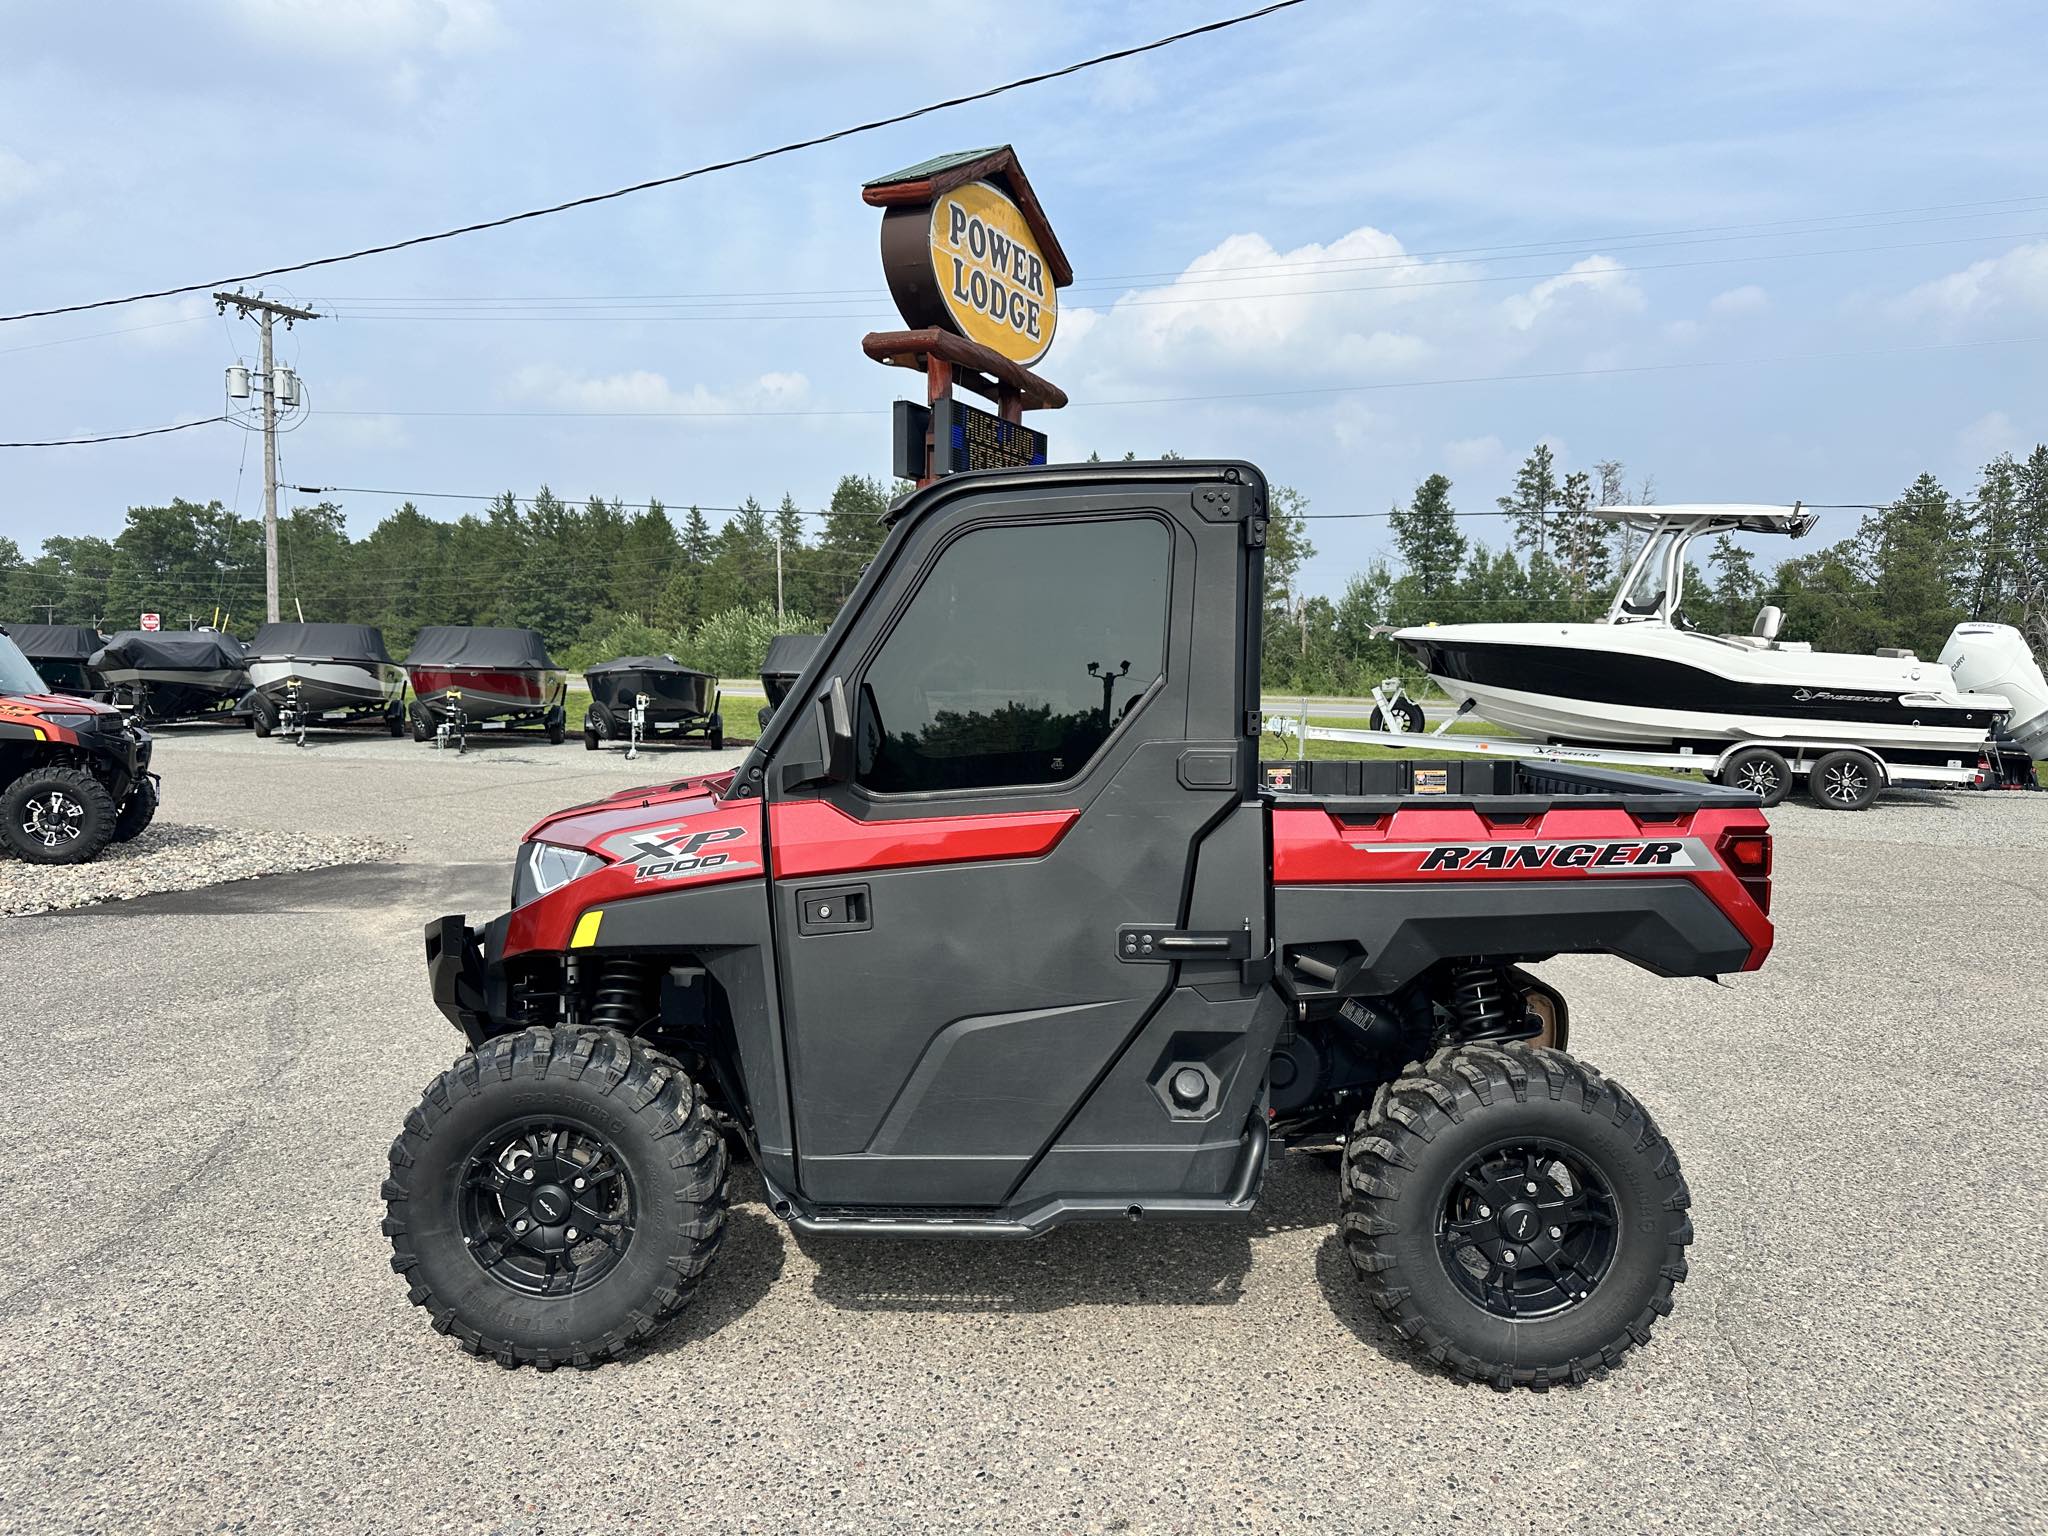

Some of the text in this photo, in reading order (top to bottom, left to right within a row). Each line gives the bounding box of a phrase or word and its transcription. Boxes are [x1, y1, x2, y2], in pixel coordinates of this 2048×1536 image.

[949, 202, 1044, 298] POWER
[952, 257, 1041, 340] LODGE
[615, 827, 747, 866] XP
[634, 854, 729, 878] 1000
[1417, 841, 1683, 872] RANGER
